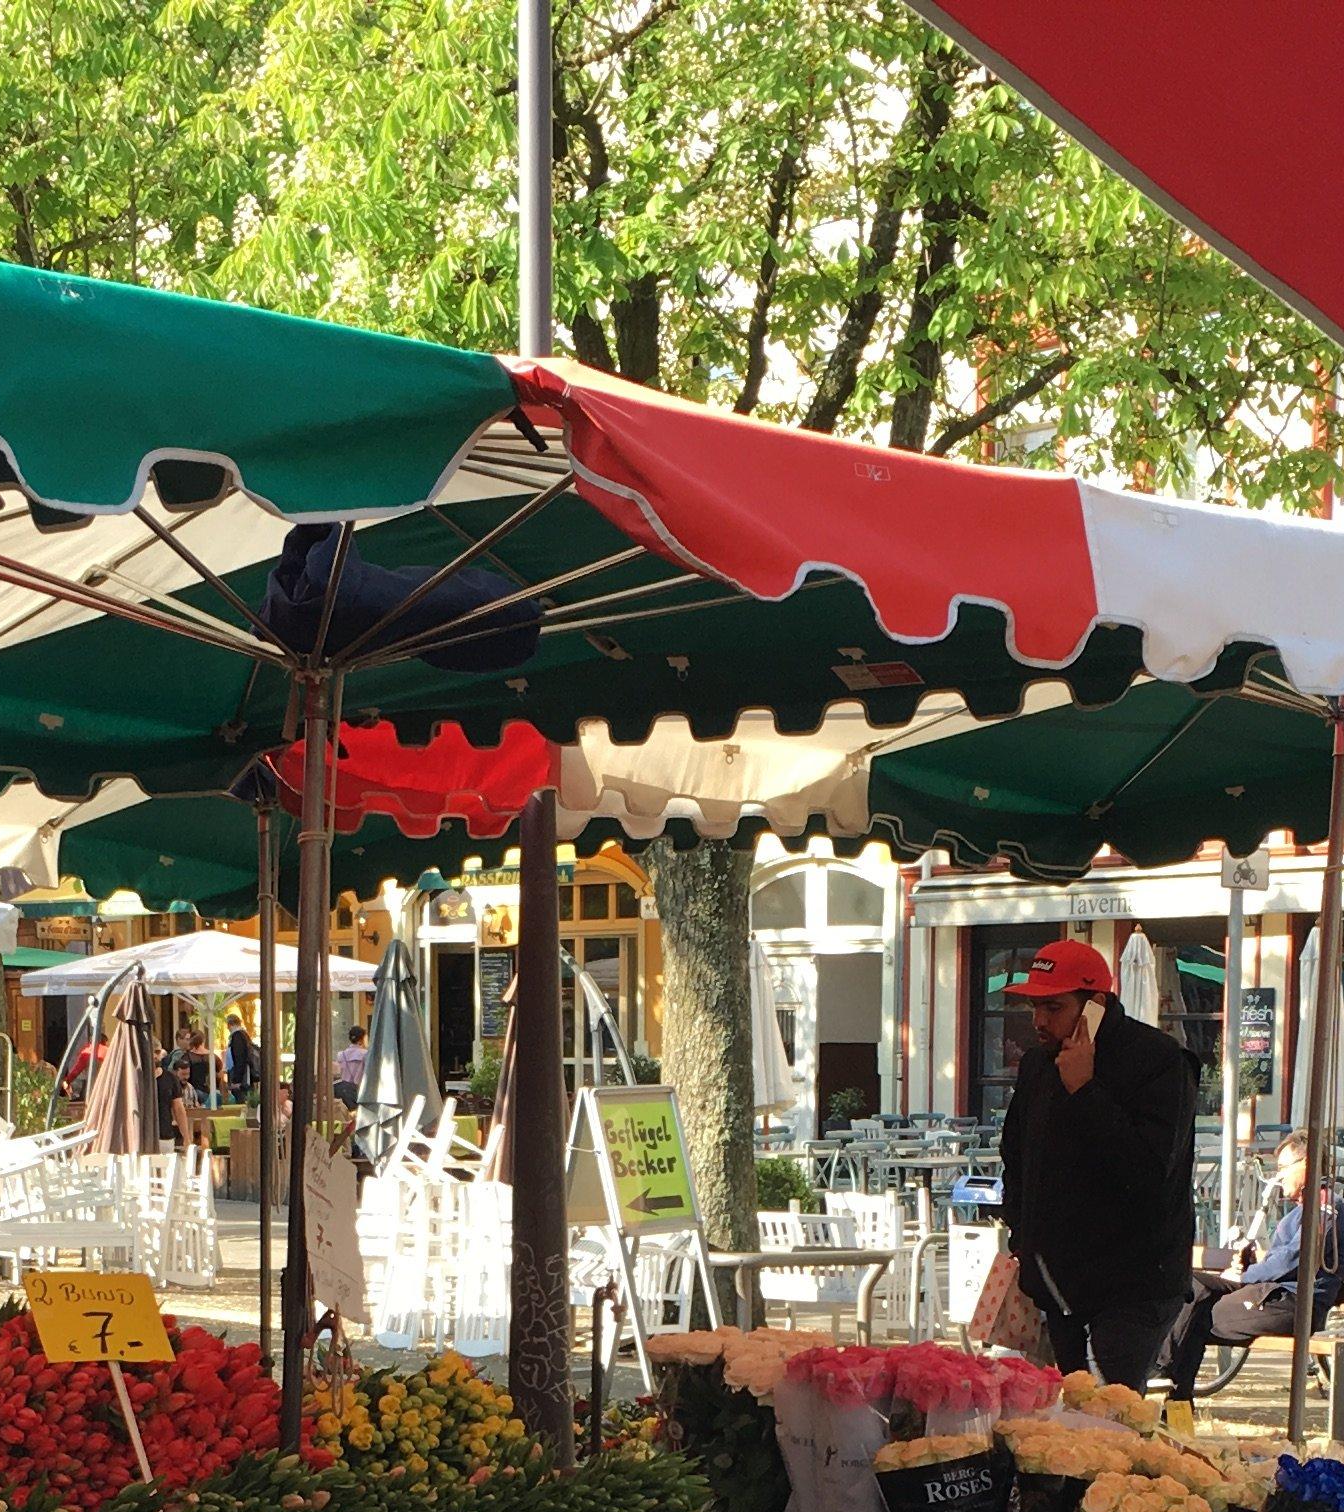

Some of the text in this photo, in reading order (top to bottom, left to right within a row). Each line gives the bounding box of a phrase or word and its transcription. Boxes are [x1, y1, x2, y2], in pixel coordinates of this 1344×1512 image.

[604, 1115, 672, 1151] Geflügel
[611, 1151, 677, 1178] Becker
[31, 1278, 53, 1306] 2
[923, 1469, 994, 1504] ROSES
[942, 1467, 976, 1482] BERG
